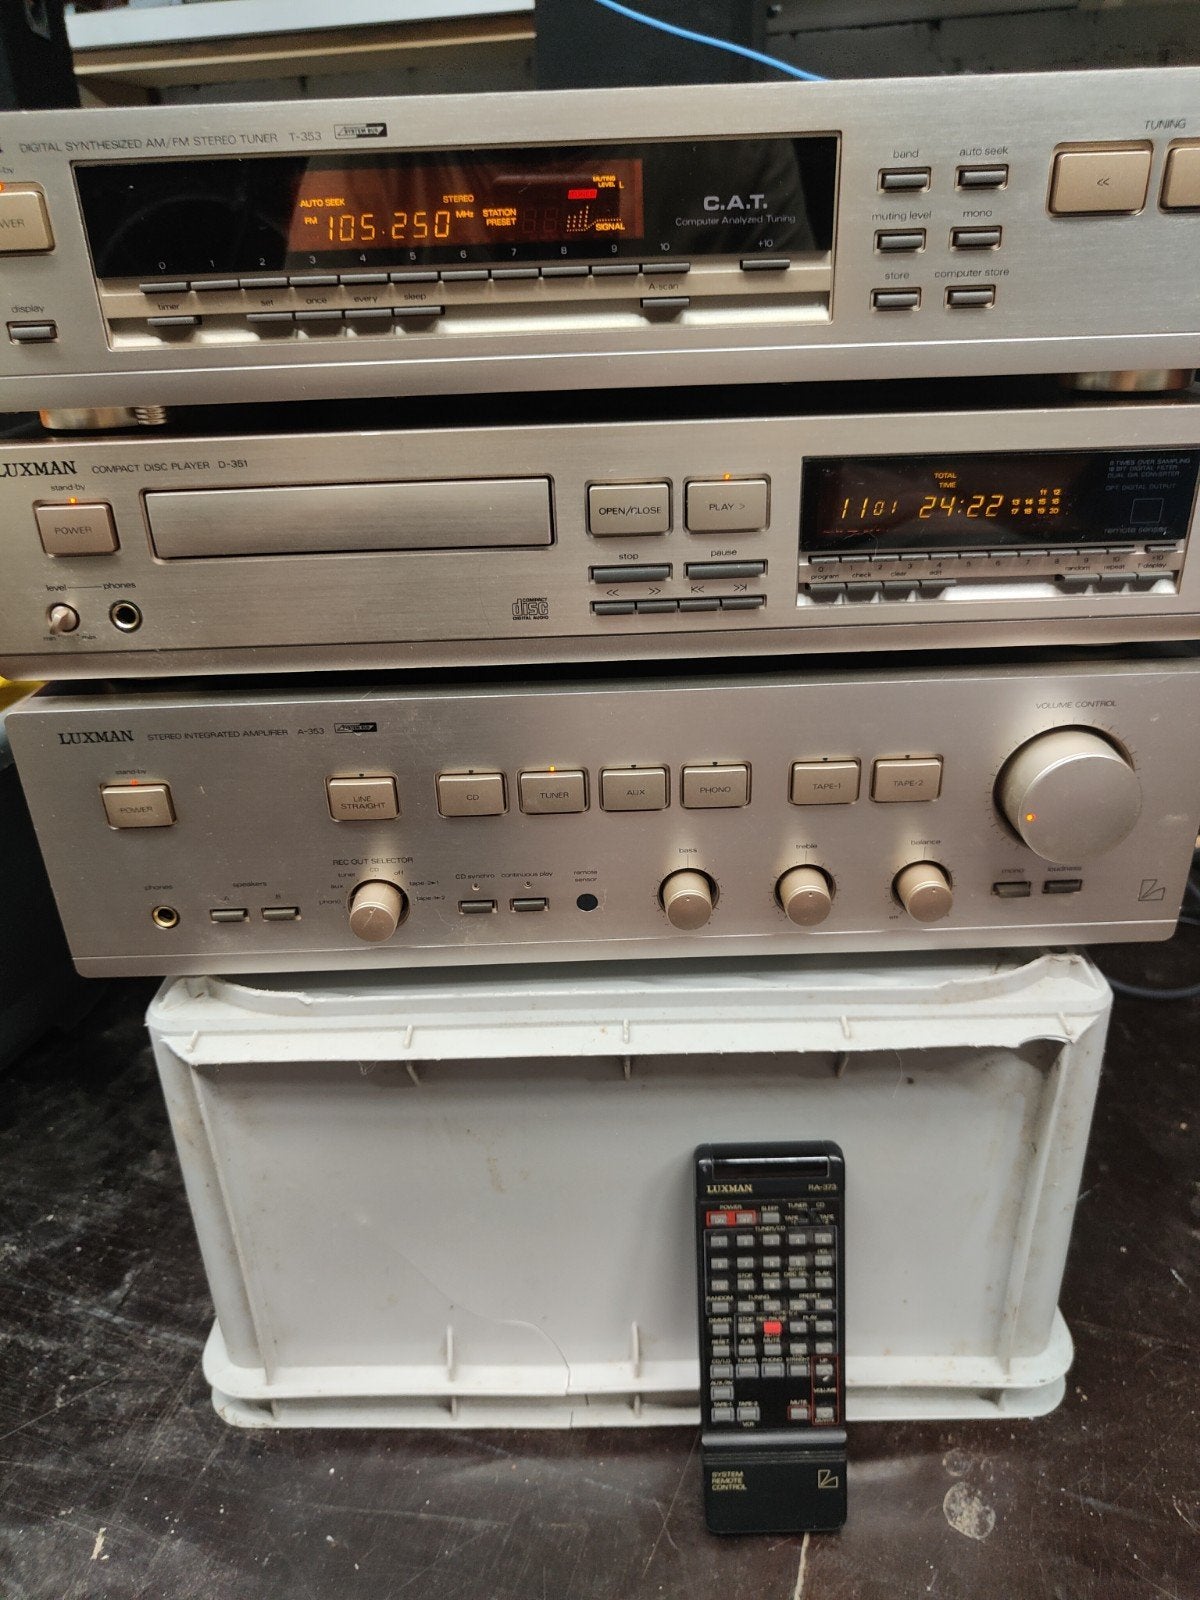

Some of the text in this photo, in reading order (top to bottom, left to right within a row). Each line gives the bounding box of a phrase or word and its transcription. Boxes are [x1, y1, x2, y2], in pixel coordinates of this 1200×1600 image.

[1145, 119, 1186, 130] TUNING
[20, 132, 322, 153] DIGITAL SYNTHESIZED AM/FM STEREO TUNER T-353
[960, 146, 1009, 157] auto seek
[300, 198, 345, 208] AUTO SEEK
[443, 195, 474, 203] STEREO
[703, 194, 768, 211] C.A.T.
[483, 208, 517, 217] STATION
[872, 211, 932, 222] muting level
[963, 210, 992, 218] mono
[304, 211, 474, 241] FM 105.250 MHz
[486, 217, 517, 226] PRESET
[675, 215, 796, 227] Computer Analyzed Tuning
[596, 223, 626, 231] SIGNAL
[159, 261, 166, 270] 0
[260, 258, 266, 266] 2
[310, 256, 317, 264] 3
[360, 254, 367, 262] 4
[410, 252, 417, 261] 5
[460, 250, 467, 259] 6
[512, 248, 517, 256] 7
[561, 247, 568, 255] 8
[611, 245, 618, 253] 9
[660, 243, 671, 251] 10
[758, 239, 774, 248] +10
[885, 272, 910, 280] store
[935, 268, 1010, 280] computer store
[354, 296, 378, 304] every
[404, 293, 427, 301] sleep
[11, 305, 45, 315] display
[92, 465, 140, 475] COMPACT
[144, 463, 169, 473] DISC
[171, 462, 211, 471] PLAYER
[599, 505, 662, 517] OPEN/CLOSE
[709, 503, 734, 512] PLAY
[919, 494, 1005, 519] 24:22
[55, 526, 93, 535] POWER
[619, 553, 639, 561] stop
[711, 549, 738, 558] pause
[1104, 564, 1126, 572] repeat
[46, 581, 136, 592] level phones
[512, 598, 549, 616] disc
[1036, 700, 1118, 710] VOLUME CONTROL
[58, 730, 134, 745] LUXMAN
[148, 728, 325, 741] STEREO INTEGRATED AMPLIFIER A-353
[700, 786, 731, 794] PHONO
[121, 806, 154, 814] POWER
[371, 857, 414, 865] SELECTOR
[233, 881, 268, 889] speakers
[707, 1184, 753, 1194] LUXMAN
